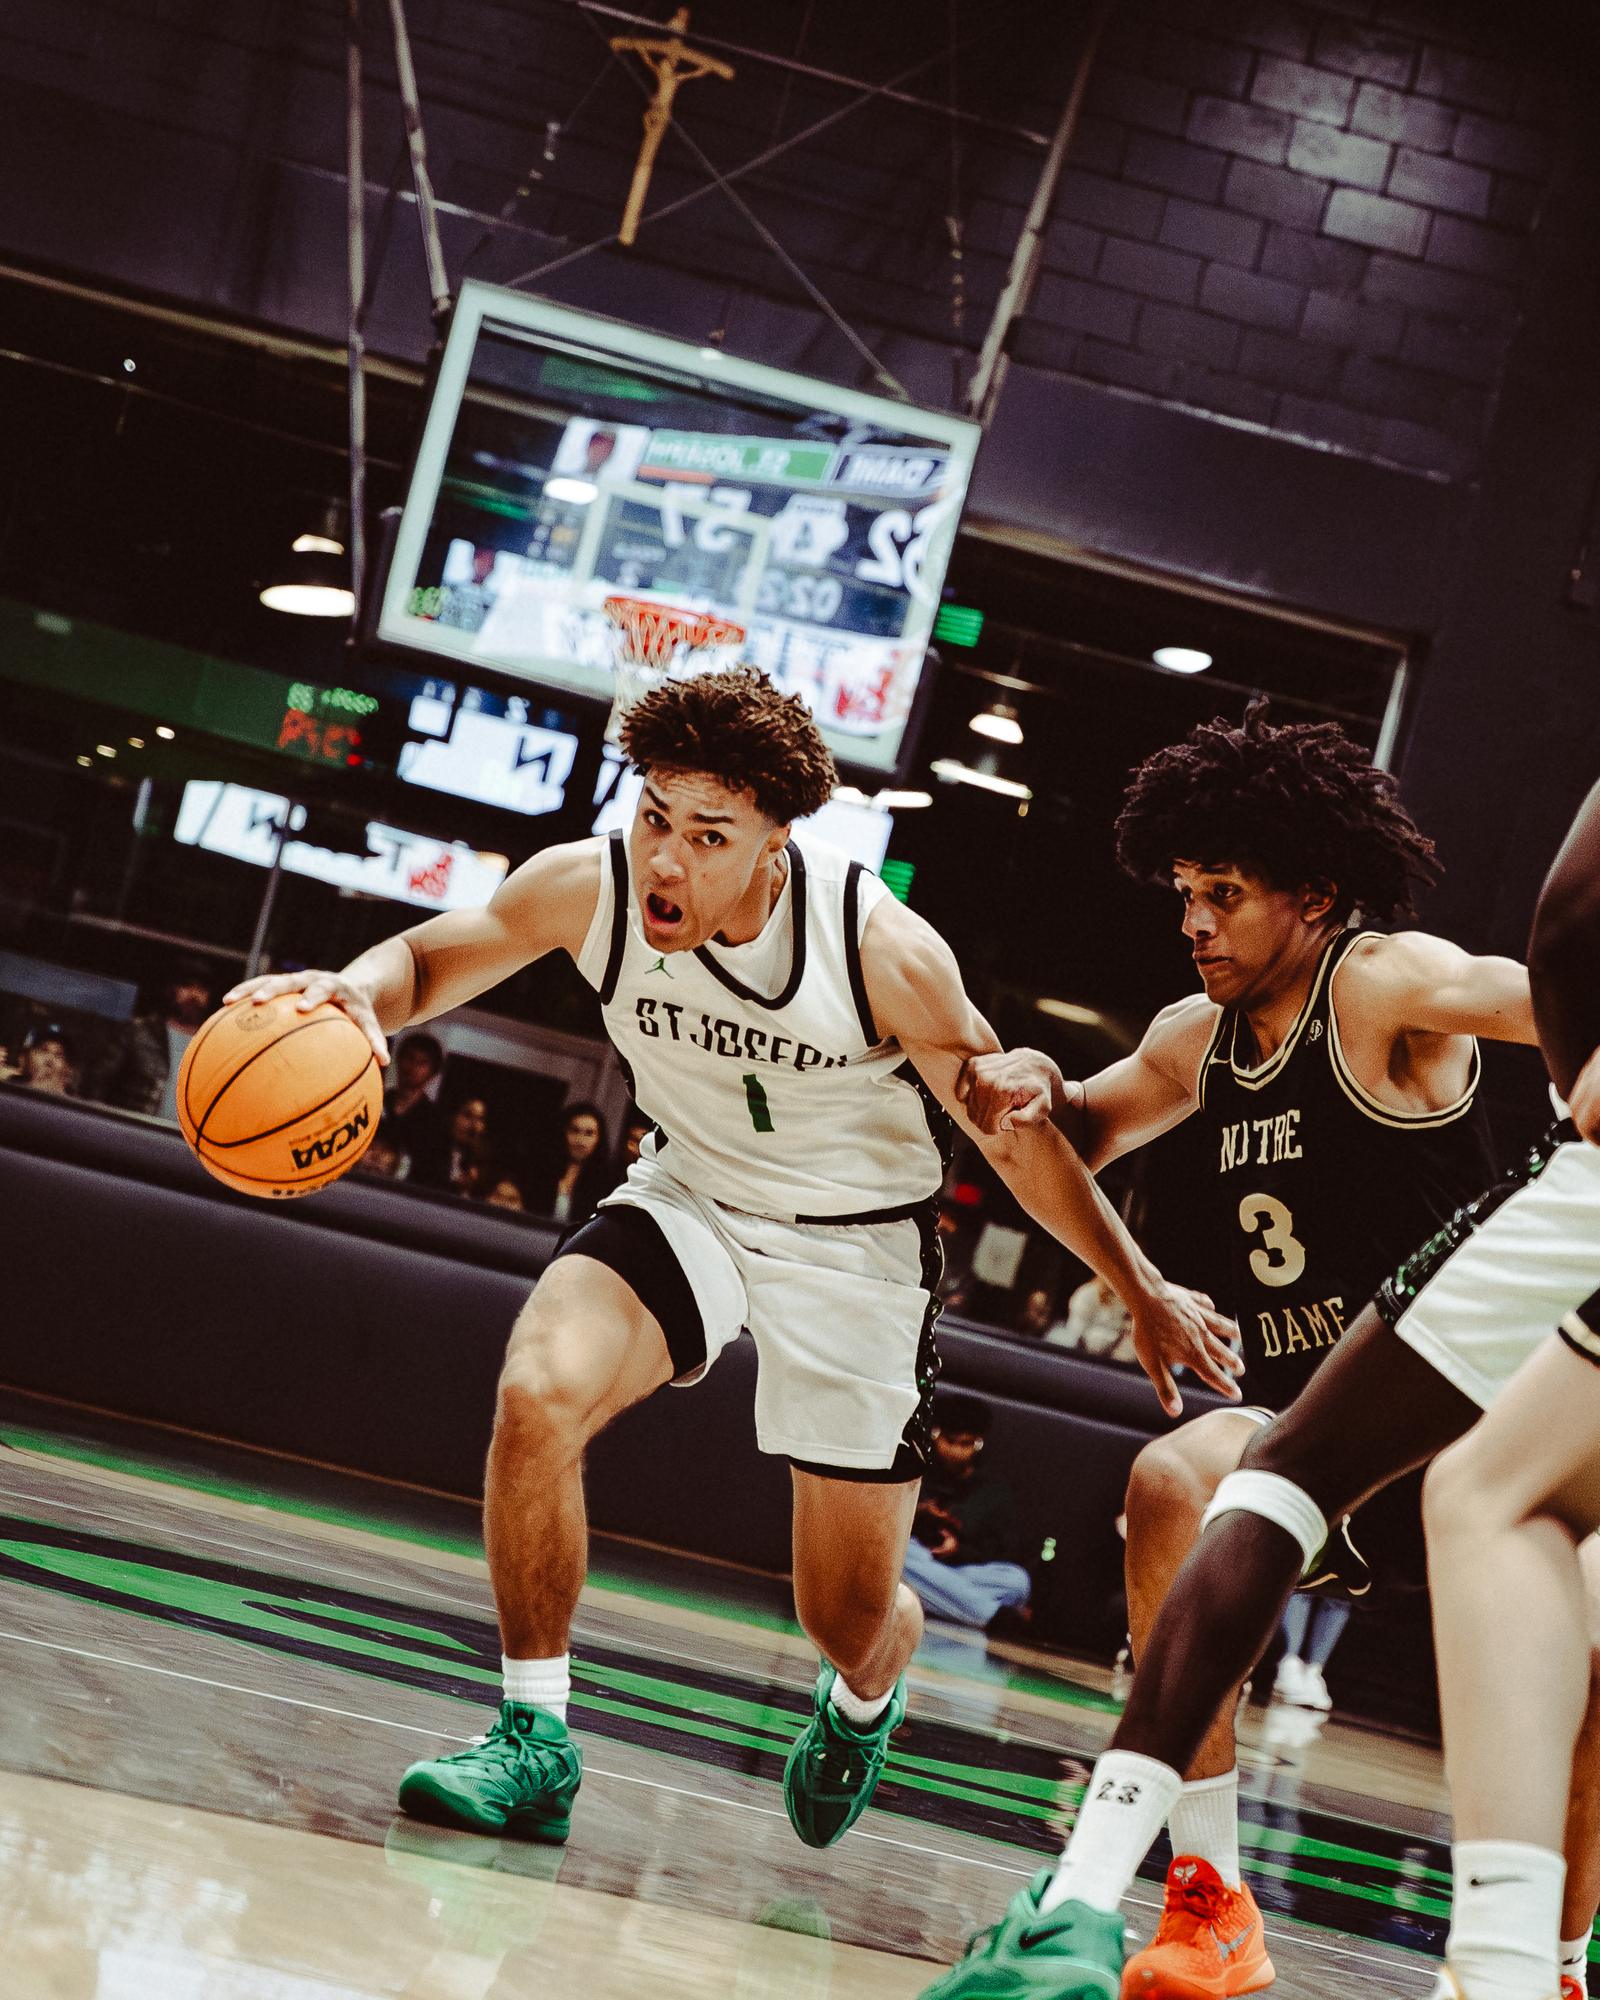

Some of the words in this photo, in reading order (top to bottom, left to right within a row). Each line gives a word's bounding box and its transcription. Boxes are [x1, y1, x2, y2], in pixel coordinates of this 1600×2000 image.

[743, 1074, 775, 1132] 1
[291, 1103, 369, 1170] NCAA
[1239, 1193, 1306, 1287] 3
[1257, 1297, 1344, 1358] DAME
